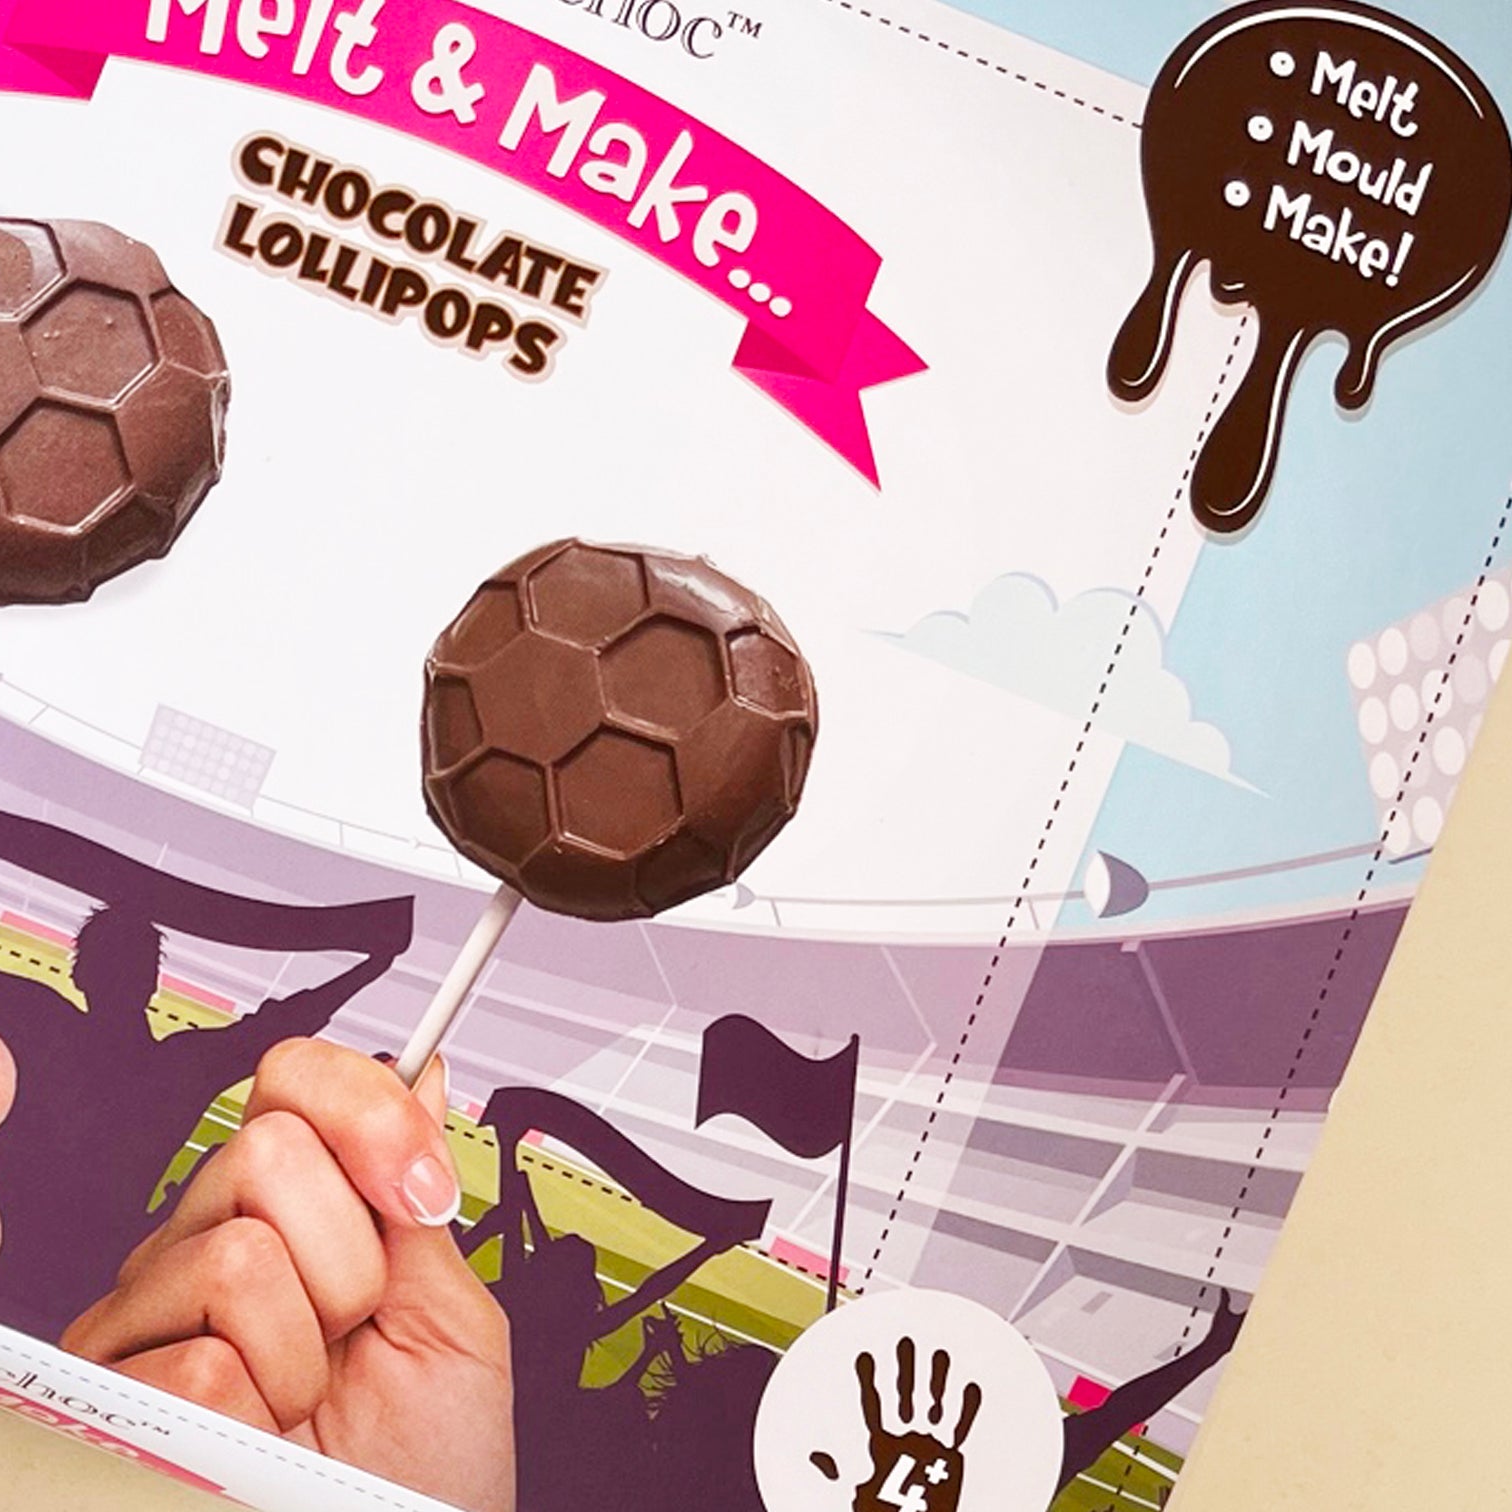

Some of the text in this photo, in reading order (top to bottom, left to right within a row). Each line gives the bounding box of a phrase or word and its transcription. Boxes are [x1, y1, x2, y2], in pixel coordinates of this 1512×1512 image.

[145, 0, 385, 95] Melt
[411, 22, 485, 123] &
[1310, 50, 1419, 137] Melt
[1287, 120, 1433, 216] Mould
[240, 136, 600, 318] CHOCOLATE
[1263, 185, 1415, 288] Make!
[224, 202, 559, 375] LOLLIPOPS
